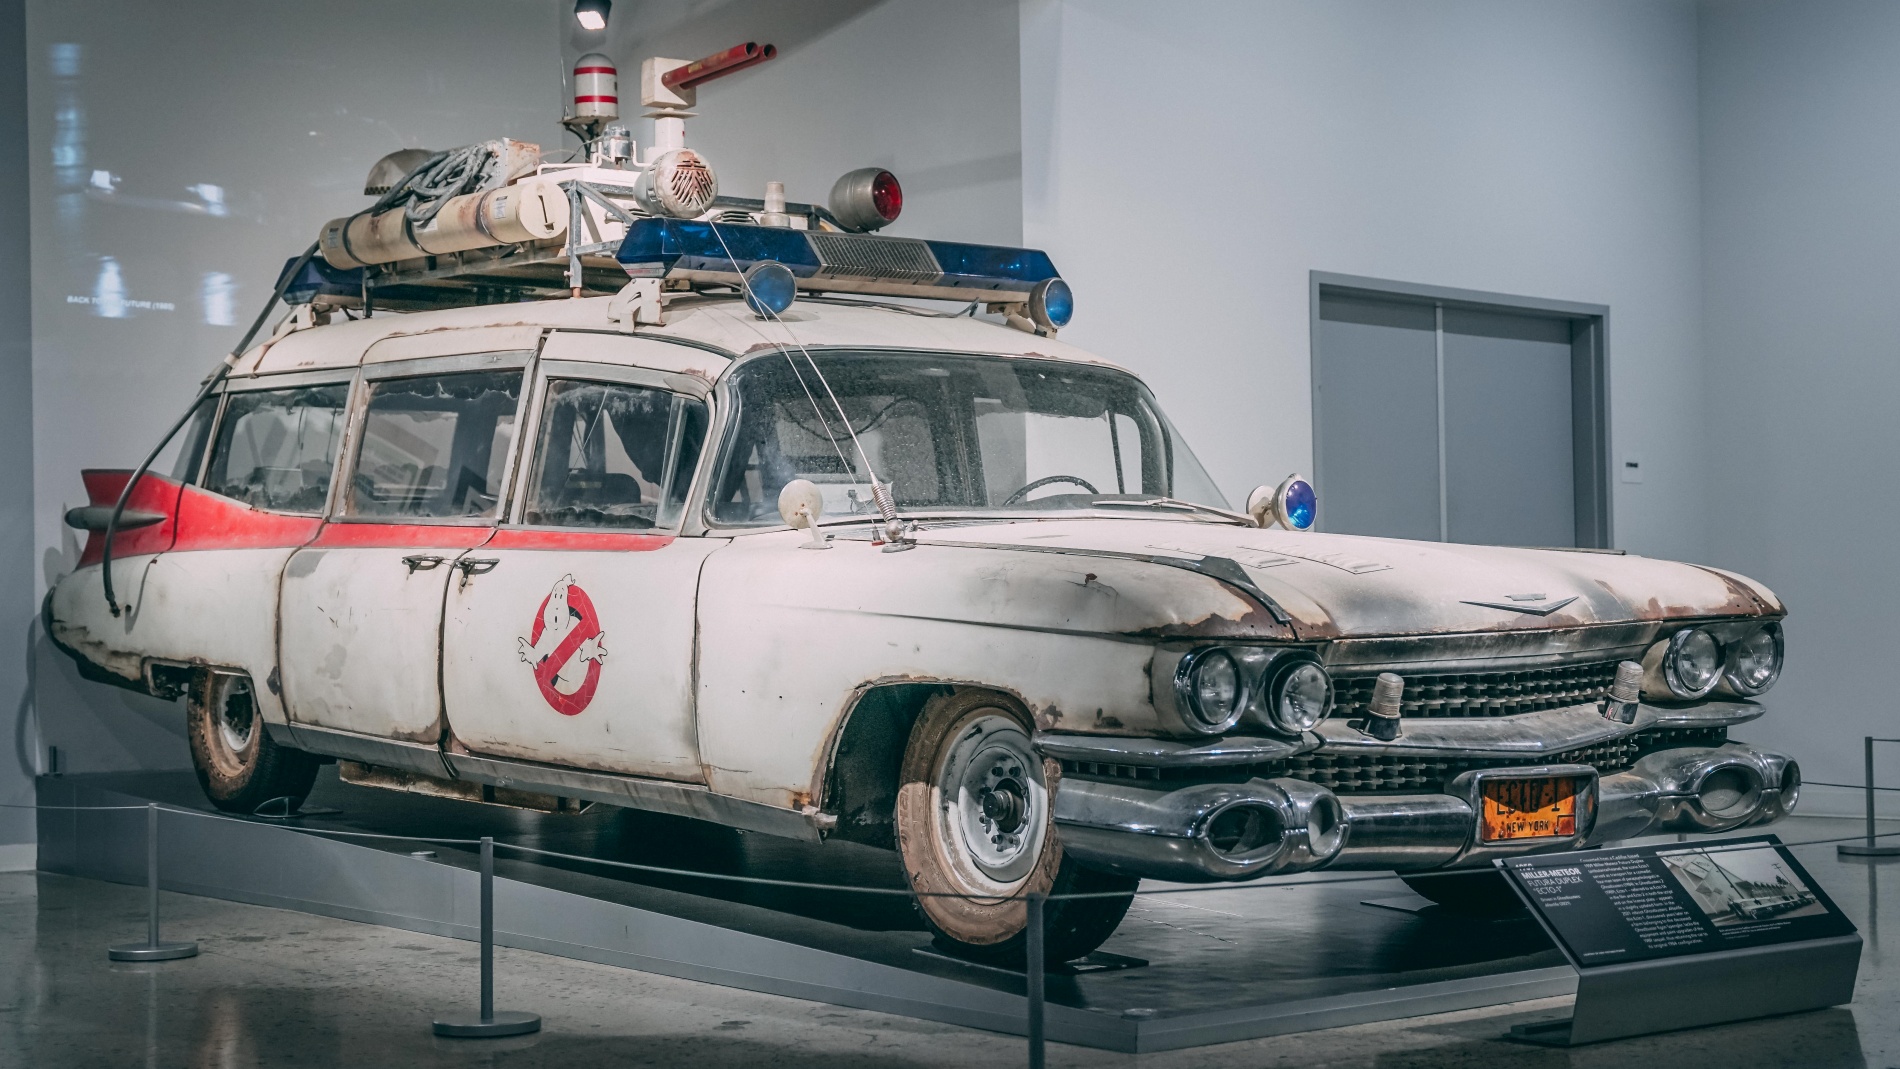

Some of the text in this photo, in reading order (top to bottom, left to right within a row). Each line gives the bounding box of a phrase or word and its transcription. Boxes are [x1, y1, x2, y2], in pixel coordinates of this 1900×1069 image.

[67, 295, 90, 304] BACK
[121, 300, 151, 309] FUTURE
[1507, 820, 1549, 833] NEW YORK
[1521, 867, 1581, 880] MILLER-METEOR
[1527, 875, 1583, 887] FUTURA DUPLEX
